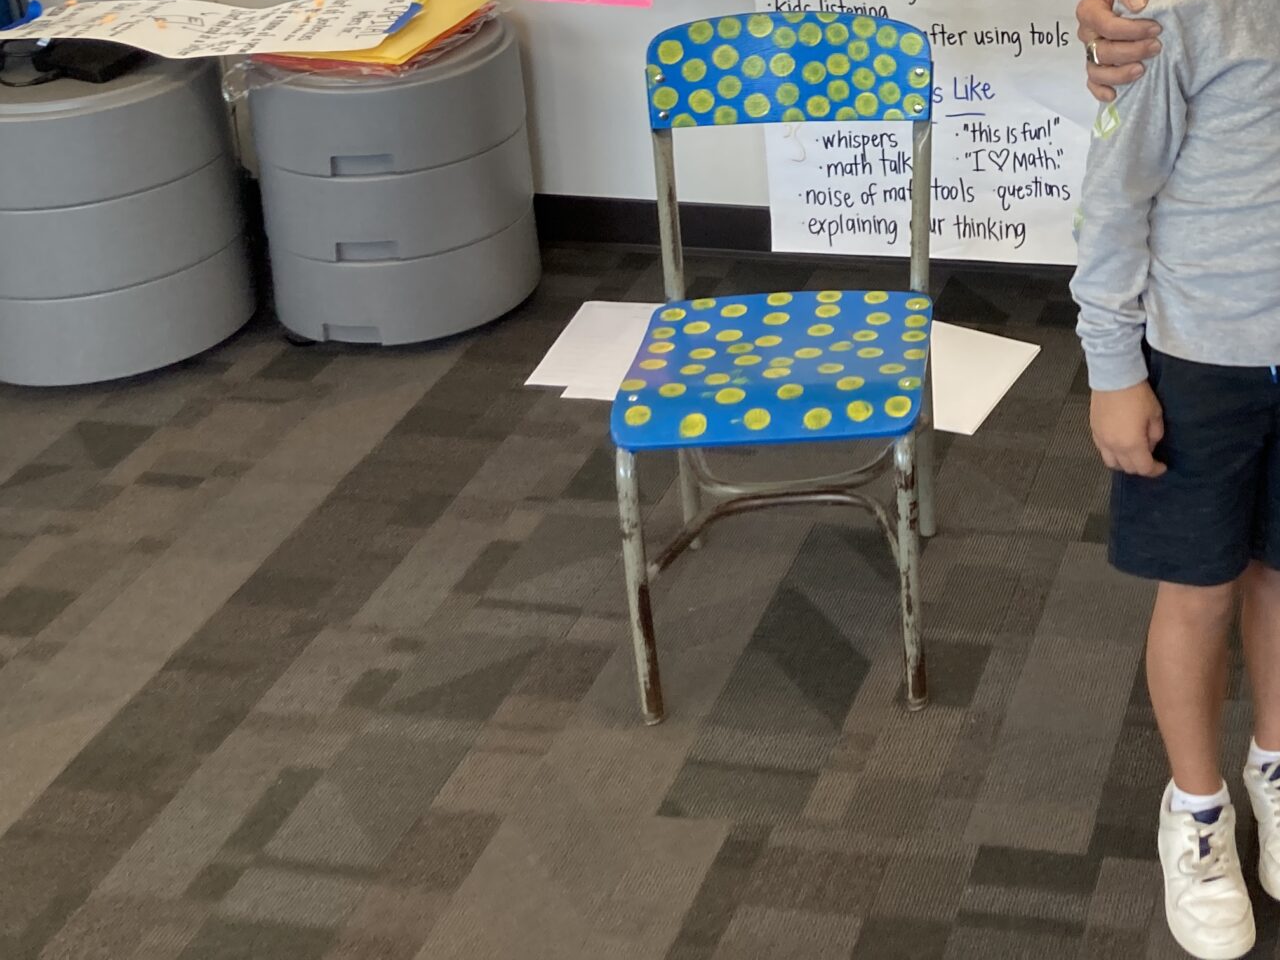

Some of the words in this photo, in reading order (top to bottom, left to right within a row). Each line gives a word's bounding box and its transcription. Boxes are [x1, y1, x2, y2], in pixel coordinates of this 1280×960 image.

[973, 26, 1023, 57] using
[1029, 21, 1071, 47] tools
[953, 74, 997, 103] Like
[822, 129, 899, 153] whispers
[826, 155, 873, 178] math
[878, 149, 914, 177] talk
[805, 184, 855, 210] noise
[860, 182, 879, 206] of
[930, 178, 976, 204] tools
[996, 175, 1072, 211] questions
[807, 212, 899, 247] explaining
[953, 215, 1027, 249] thinking
